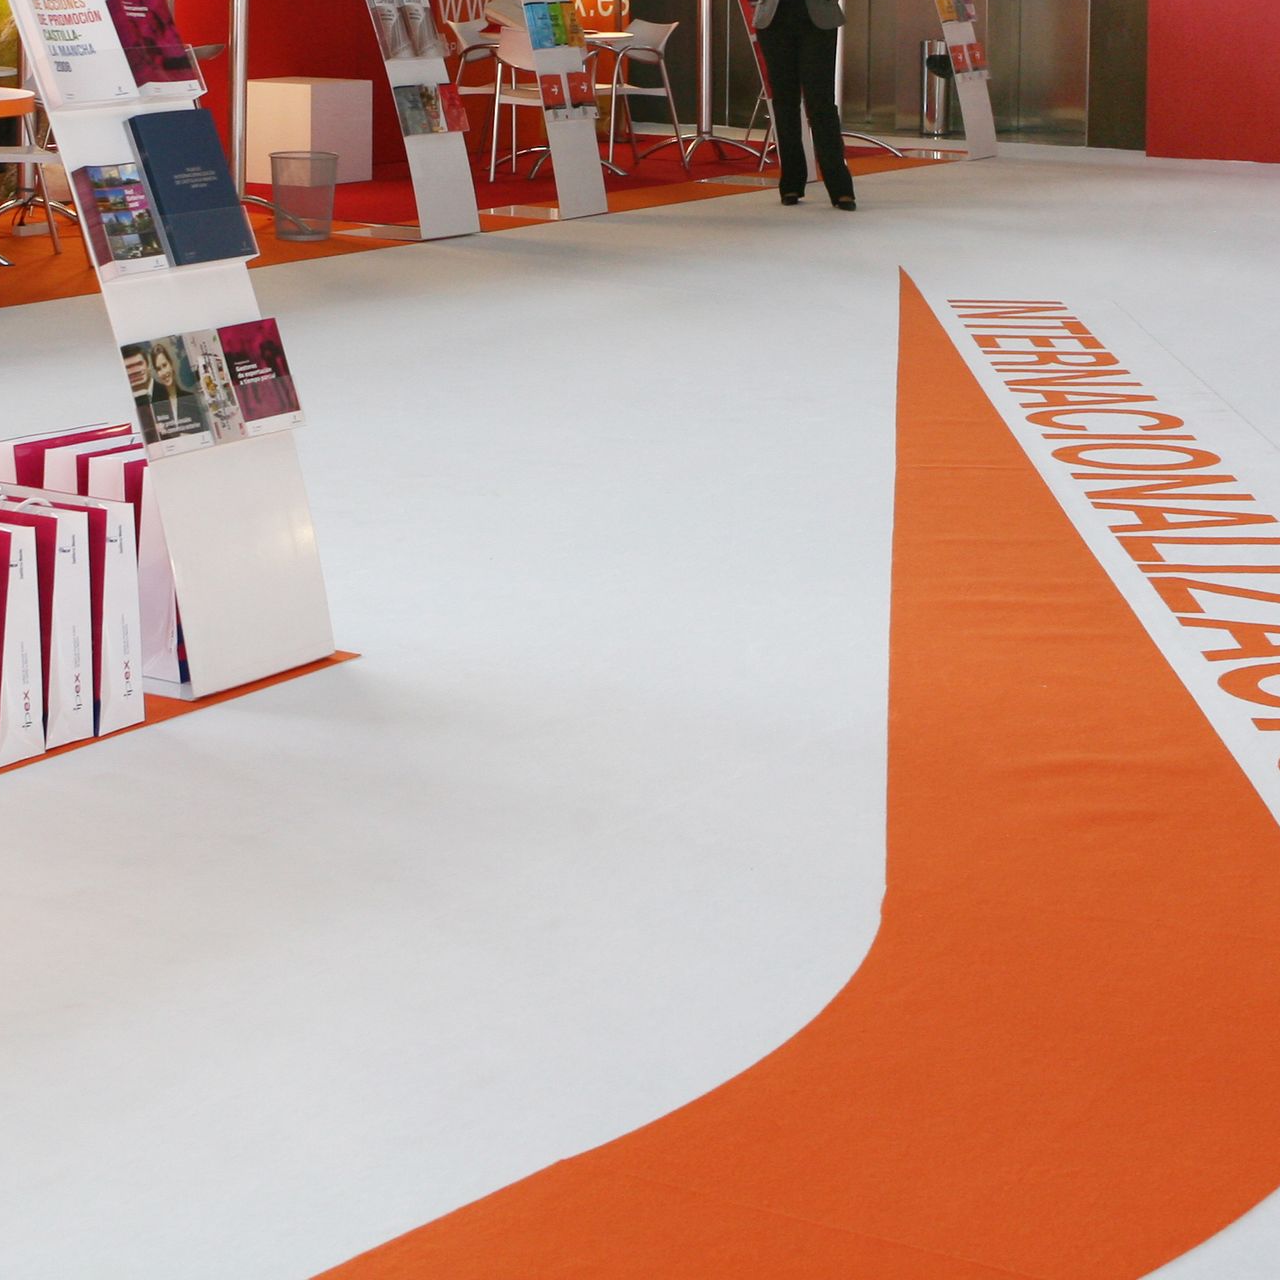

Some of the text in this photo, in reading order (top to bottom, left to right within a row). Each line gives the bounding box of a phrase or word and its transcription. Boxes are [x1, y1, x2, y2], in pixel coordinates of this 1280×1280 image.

[37, 8, 102, 26] DE PROMOCIÓN
[48, 43, 96, 56] LA MANCHA
